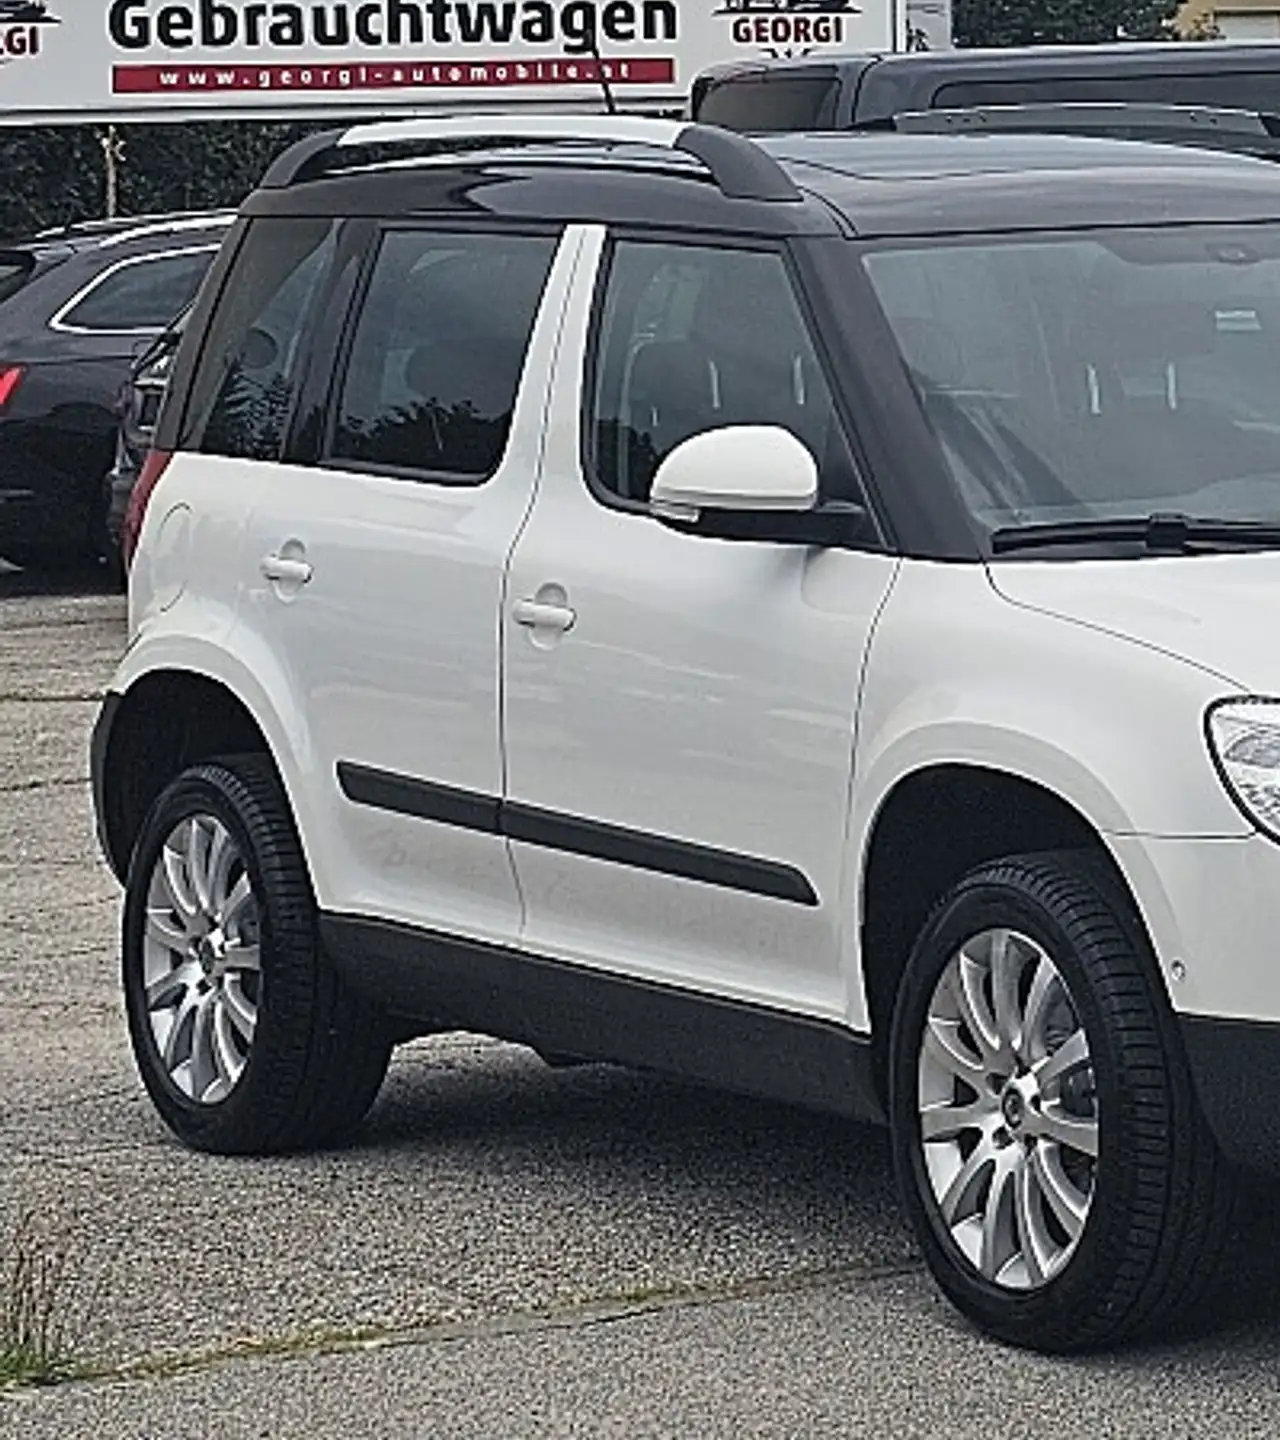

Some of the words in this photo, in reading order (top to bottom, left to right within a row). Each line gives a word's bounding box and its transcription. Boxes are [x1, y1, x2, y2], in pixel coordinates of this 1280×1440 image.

[0, 25, 39, 56] GI
[732, 16, 843, 43] GEORGI
[159, 62, 630, 88] www.georgi-automobile.at
